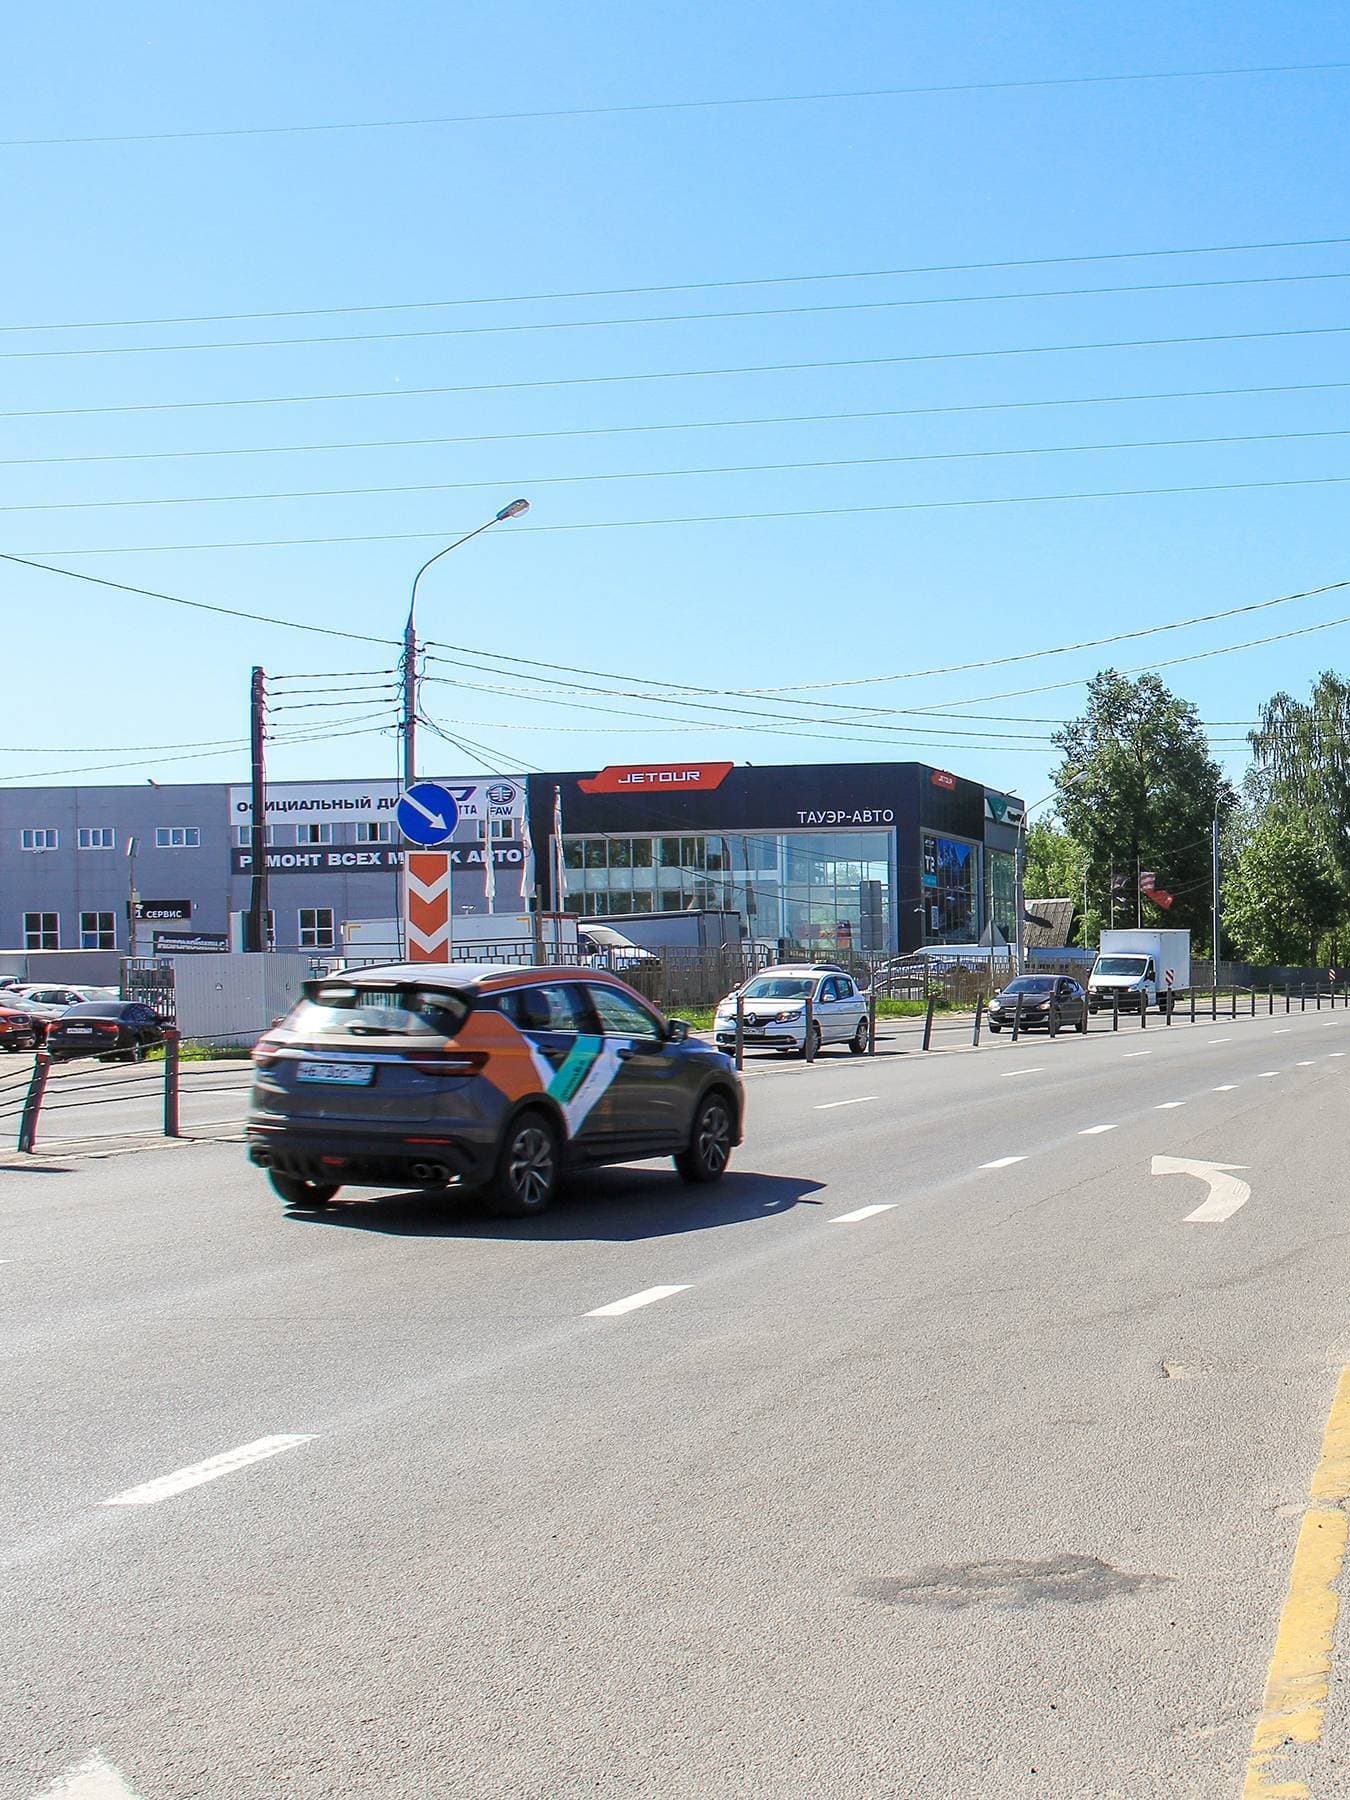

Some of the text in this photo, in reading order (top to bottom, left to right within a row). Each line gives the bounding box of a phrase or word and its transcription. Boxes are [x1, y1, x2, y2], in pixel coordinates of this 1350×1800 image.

[618, 771, 700, 783] JETOUR
[237, 796, 371, 812] ОИЦИАЛЬНЫЙ
[490, 806, 513, 815] FAW
[797, 809, 894, 824] ТАУЭР-АВТО
[240, 853, 322, 868] РМОНТ
[328, 852, 381, 866] ВСЕХ
[146, 910, 182, 918] СЕРВИС
